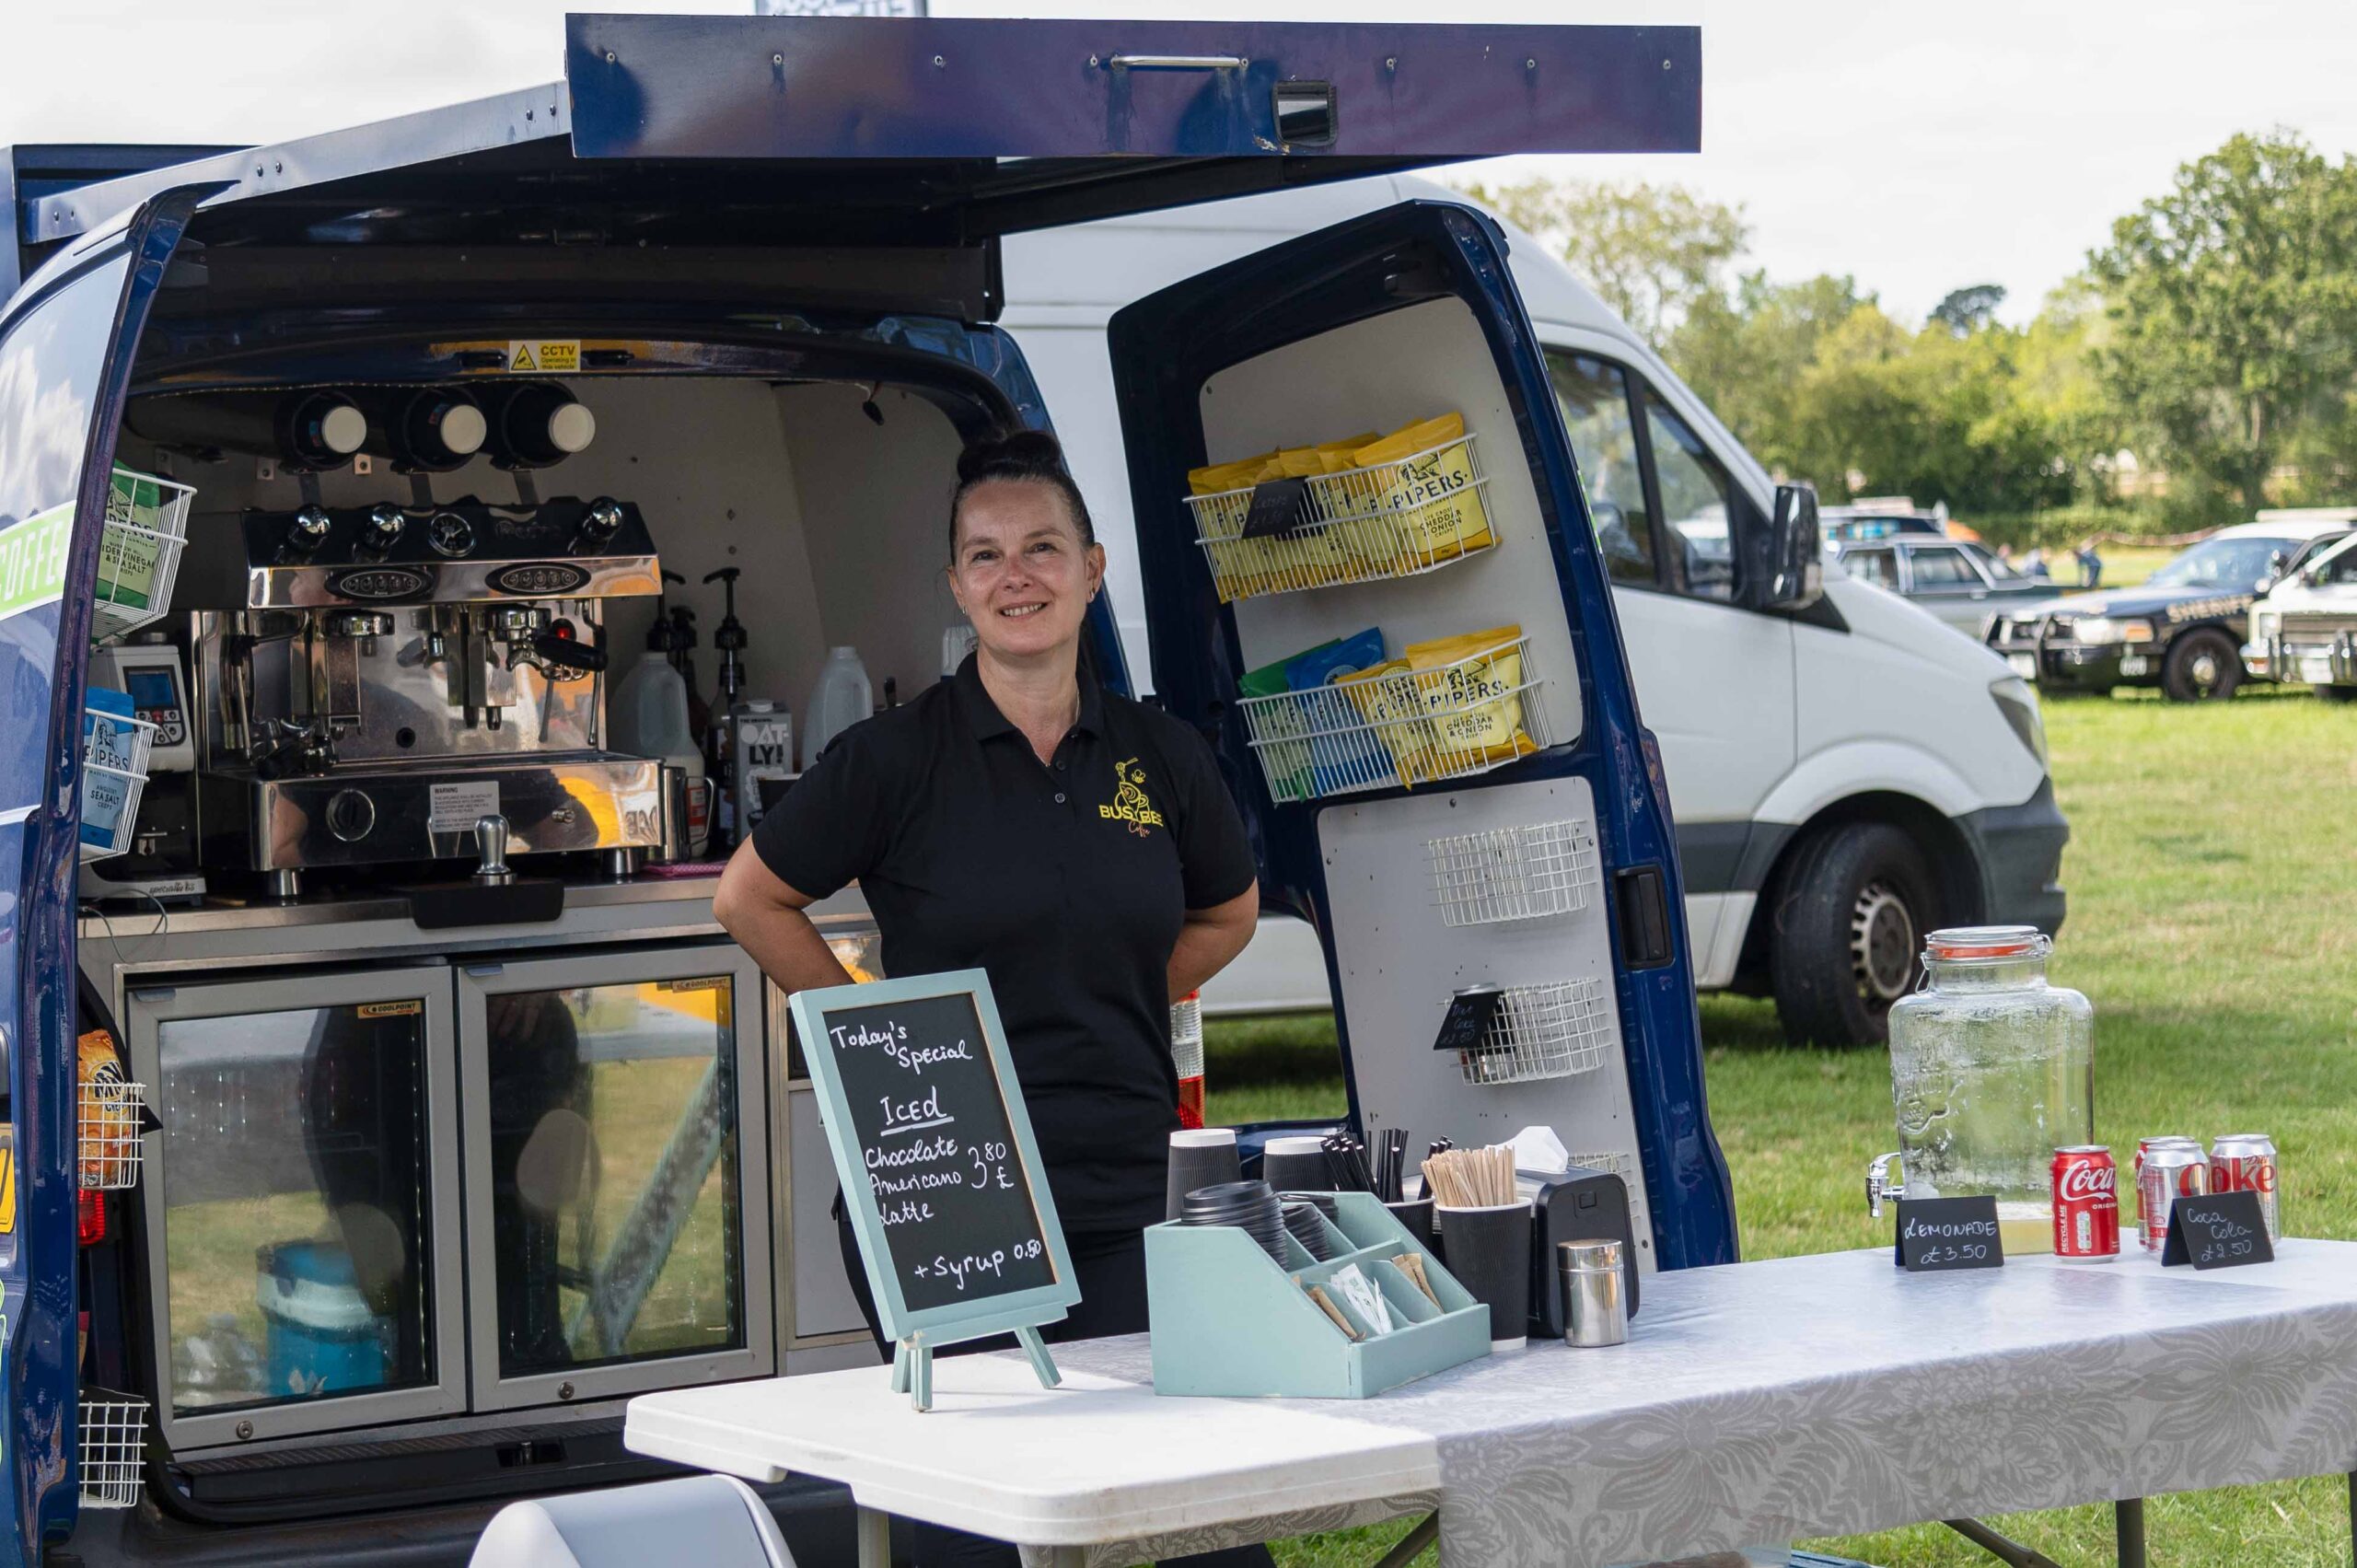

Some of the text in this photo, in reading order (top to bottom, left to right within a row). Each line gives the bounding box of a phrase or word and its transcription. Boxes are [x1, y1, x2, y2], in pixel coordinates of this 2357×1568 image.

[540, 345, 576, 356] CCTV
[1391, 470, 1465, 510] PIPERS
[1420, 509, 1462, 531] CHEDDAR
[1431, 517, 1462, 534] ONION
[101, 544, 121, 556] IDER
[128, 562, 146, 575] SALT
[1429, 679, 1504, 710] PIPERS
[1446, 715, 1493, 731] CHEDDAR
[1457, 724, 1492, 736] ONION
[83, 744, 129, 772] PIPERS
[749, 744, 784, 765] LY!
[90, 789, 121, 807] SEA SALT
[377, 1003, 416, 1013] COOLPOINT
[830, 1020, 908, 1056] Today's
[869, 1169, 962, 1197] Americano
[2211, 1157, 2276, 1194] oke
[1904, 1217, 1997, 1240] LEMONADE
[2059, 1204, 2069, 1253] RECYCLE ME
[1014, 1238, 1042, 1260] 0.50
[1921, 1244, 1988, 1265] £3.50
